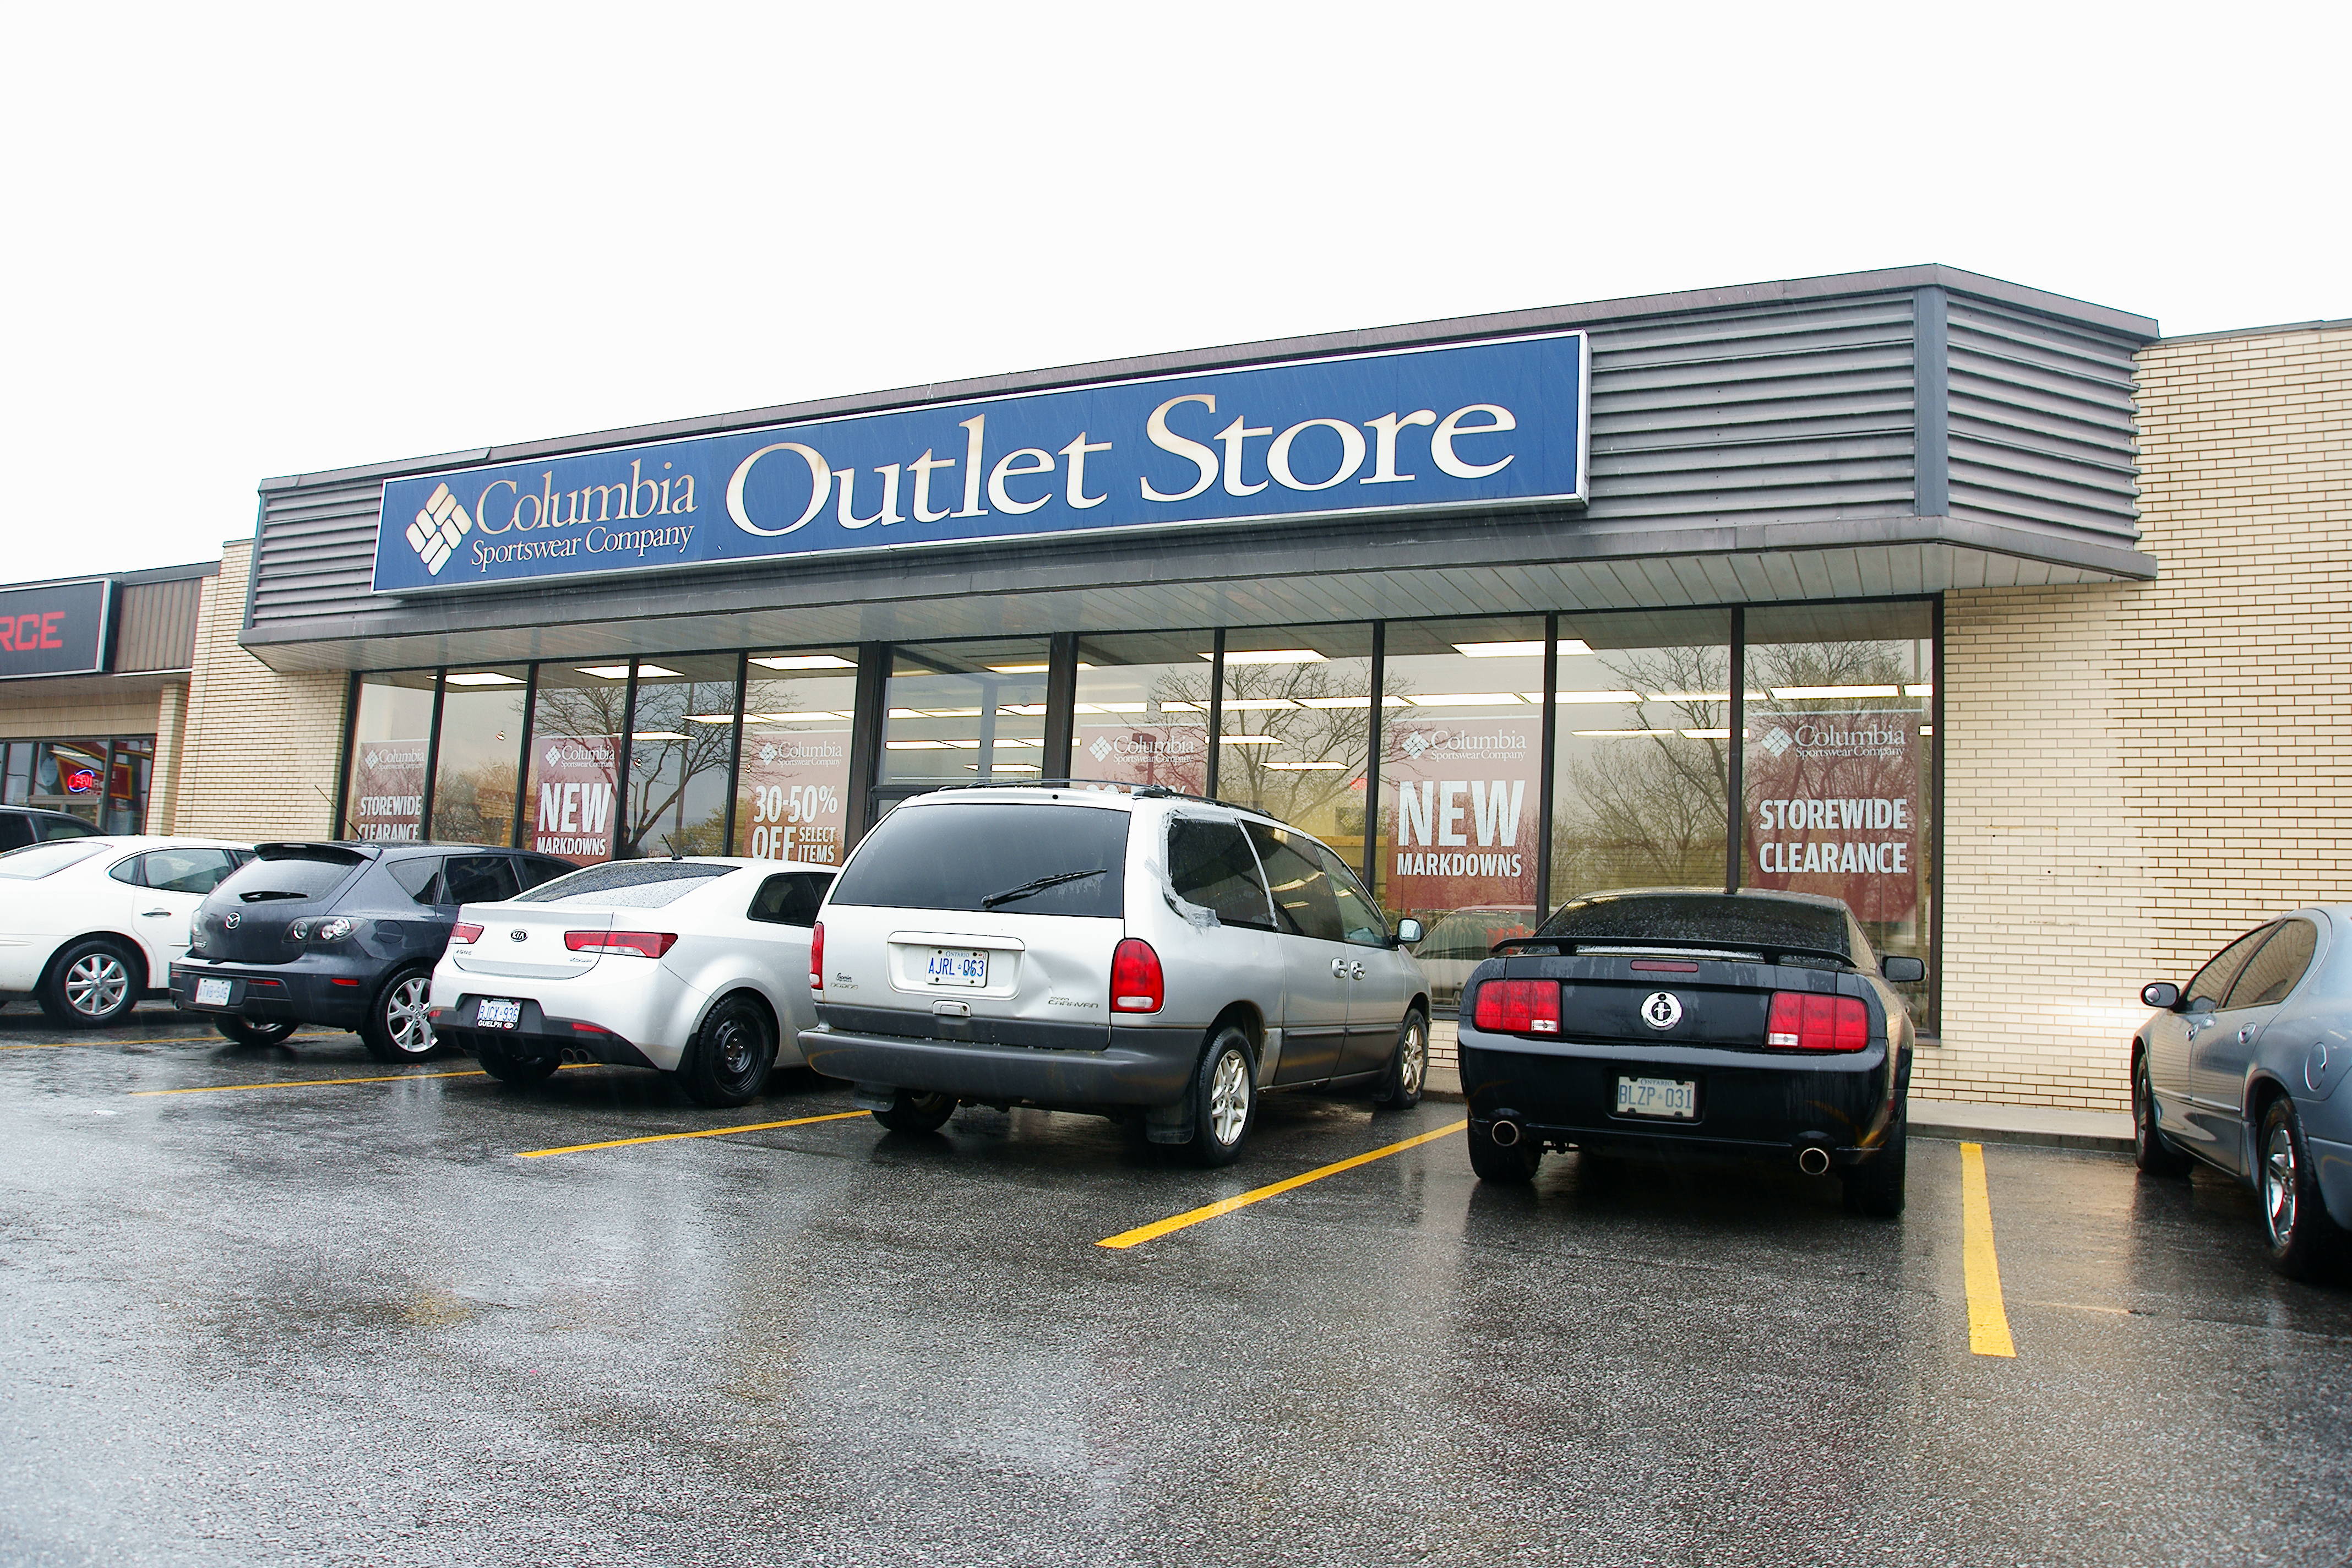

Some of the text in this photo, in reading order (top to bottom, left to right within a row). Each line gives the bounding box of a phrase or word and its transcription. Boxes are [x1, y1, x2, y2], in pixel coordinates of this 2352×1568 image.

[726, 394, 1517, 537] Outlet Store
[476, 459, 698, 535] Columbia
[471, 525, 695, 573] Sportswear Company
[0, 611, 66, 651] RCE
[1113, 735, 1194, 754] Columbia
[1431, 729, 1527, 750] Columbia
[1795, 725, 1905, 747] Columbia
[378, 749, 425, 763] Columbia
[561, 745, 615, 760] Columbia
[778, 741, 842, 758] Columbia
[1113, 754, 1194, 765] Sportswear Company
[1431, 749, 1526, 762] Sportswear Company
[1795, 746, 1905, 760] Sportswear Company
[560, 760, 588, 769] Sportswear
[777, 758, 842, 768] Sportswear Company
[360, 796, 422, 816] STOREWIDE
[538, 783, 612, 833] NEW
[753, 785, 838, 823] 30-50%
[1398, 780, 1526, 847] NEW
[1760, 798, 1908, 830] STOREWIDE
[752, 826, 797, 861] OFF
[799, 826, 836, 842] SELECT
[536, 836, 606, 856] MARKDOWNS
[798, 845, 835, 863] ITEMS
[1397, 853, 1522, 878] MARKDOWNS
[1759, 842, 1908, 873] CLEARANCE
[511, 931, 525, 939] KIA
[477, 1020, 503, 1028] GUELPH
[1640, 1078, 1673, 1087] ONTARIO
